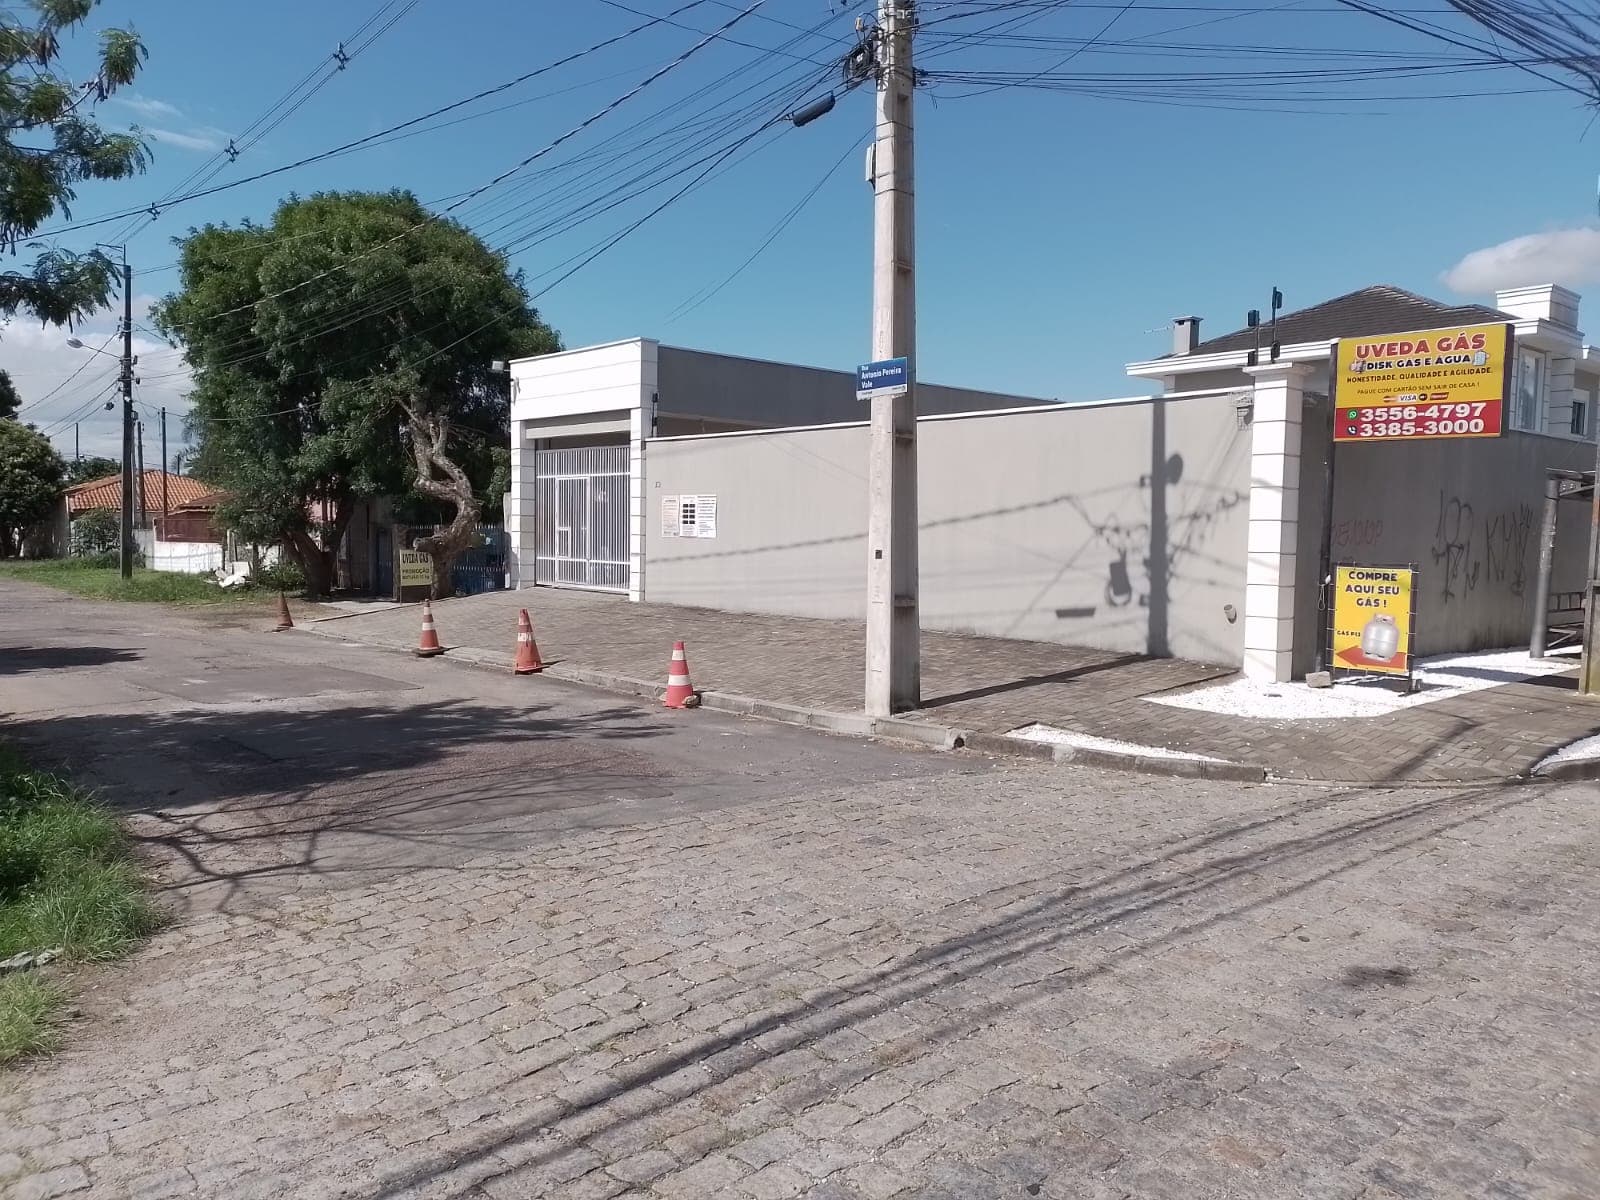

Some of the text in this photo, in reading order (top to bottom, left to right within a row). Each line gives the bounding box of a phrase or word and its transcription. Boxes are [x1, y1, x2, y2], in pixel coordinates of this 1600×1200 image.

[1356, 332, 1486, 359] UVEDA GÁS
[1367, 361, 1393, 370] DISK
[1425, 357, 1431, 365] E
[883, 367, 902, 376] Pereira
[1399, 370, 1441, 380] QUALIDADE
[861, 381, 873, 389] Vale
[1393, 384, 1417, 393] CARTÃO
[1459, 381, 1475, 389] CASA
[1400, 394, 1417, 402] VISA
[1360, 402, 1487, 422] 3556-4797
[1360, 418, 1485, 437] 3385-3000
[1348, 571, 1398, 581] COMPRE
[1345, 584, 1400, 595] AQUI SEU
[1356, 596, 1380, 607] GÁS
